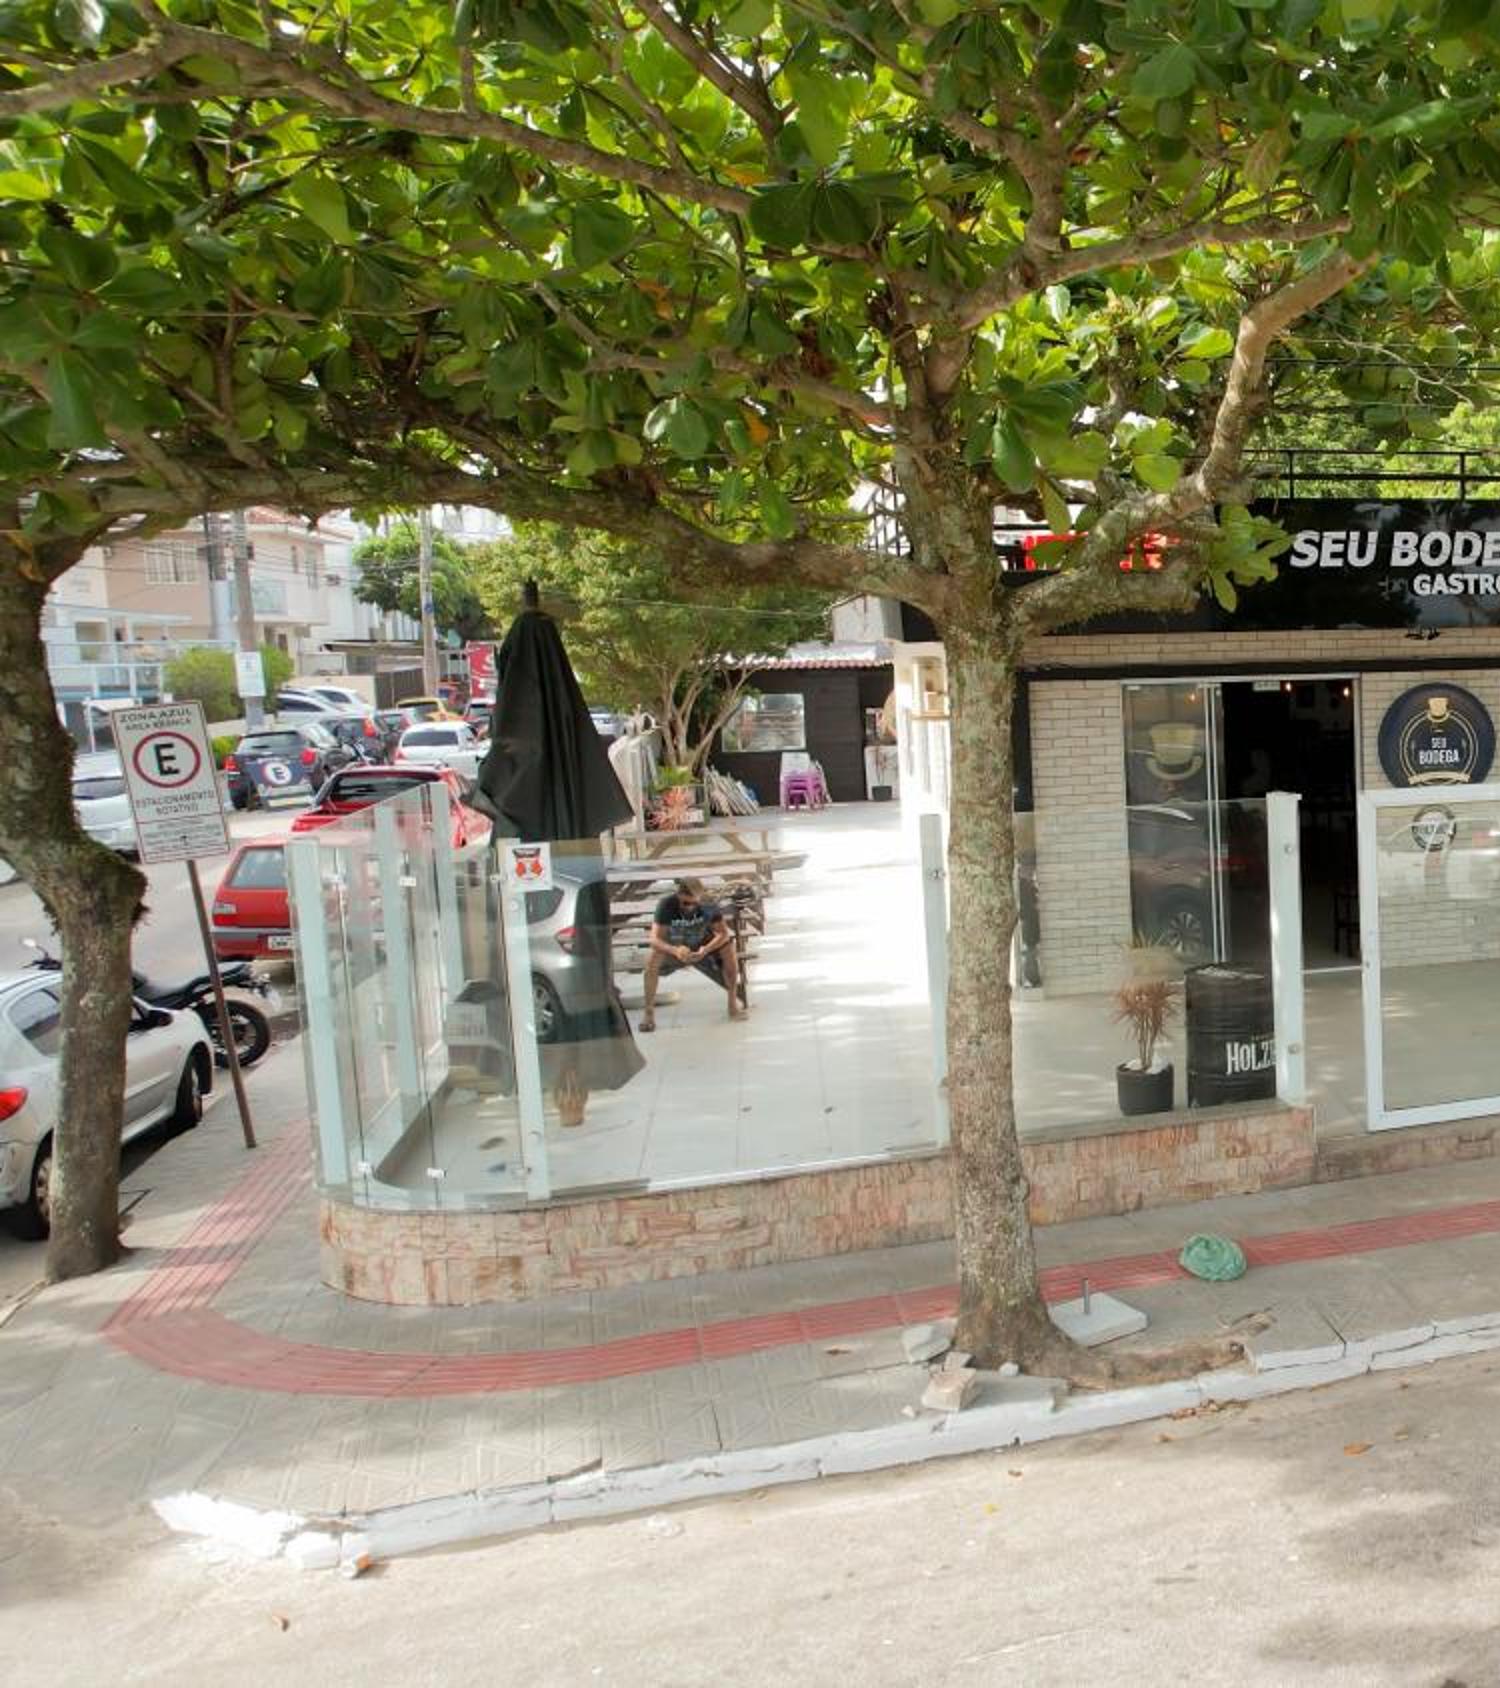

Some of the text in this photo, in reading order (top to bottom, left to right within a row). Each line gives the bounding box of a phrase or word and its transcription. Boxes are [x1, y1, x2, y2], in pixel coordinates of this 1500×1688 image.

[1290, 531, 1378, 568] SEU
[119, 709, 193, 723] ZONA AZUL
[1431, 737, 1447, 749] SEU
[154, 743, 180, 776] E
[1419, 749, 1460, 765] BODEGA
[135, 790, 215, 809] ESTACIONAMENTO
